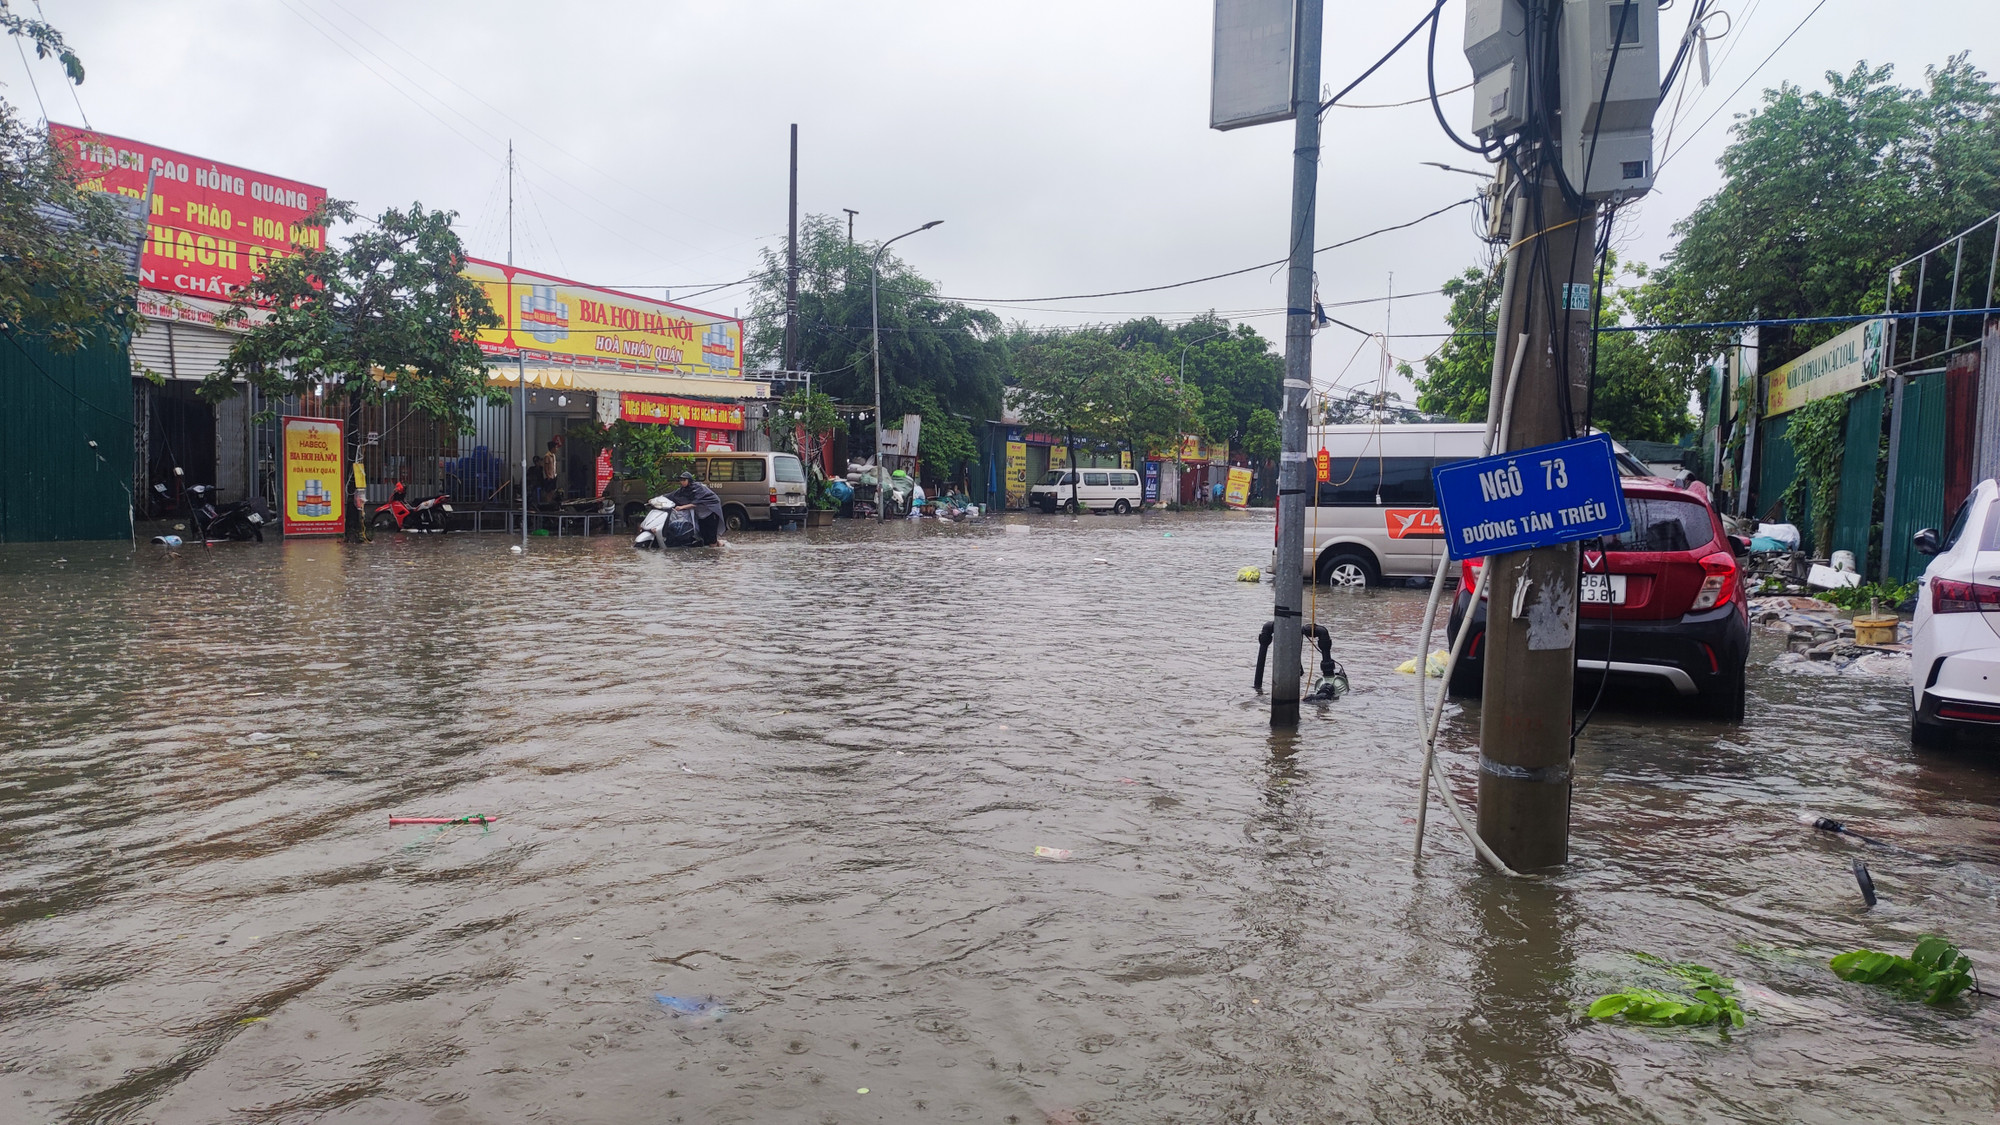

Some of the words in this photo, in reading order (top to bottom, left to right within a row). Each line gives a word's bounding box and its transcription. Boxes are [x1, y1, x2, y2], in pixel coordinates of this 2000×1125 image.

[78, 140, 144, 172] THẠCH
[151, 157, 189, 183] CAO
[196, 164, 245, 196] HỒNG
[251, 181, 308, 211] QUANG
[186, 202, 232, 230] PHÀO
[252, 216, 285, 241] HOA
[143, 225, 237, 270] THẠCH
[578, 298, 609, 326] BIA
[610, 305, 640, 331] HƠI
[642, 309, 666, 336] HÀ
[667, 315, 694, 345] NỘI
[655, 344, 684, 364] QUÁN
[299, 440, 327, 449] HABECO
[1478, 459, 1524, 502] NGÕ
[1539, 458, 1569, 491] 73
[1420, 513, 1443, 526] LA
[1462, 519, 1518, 544] ĐƯỜNG
[1520, 510, 1554, 534] TÂN
[1558, 498, 1607, 526] TRIỀU
